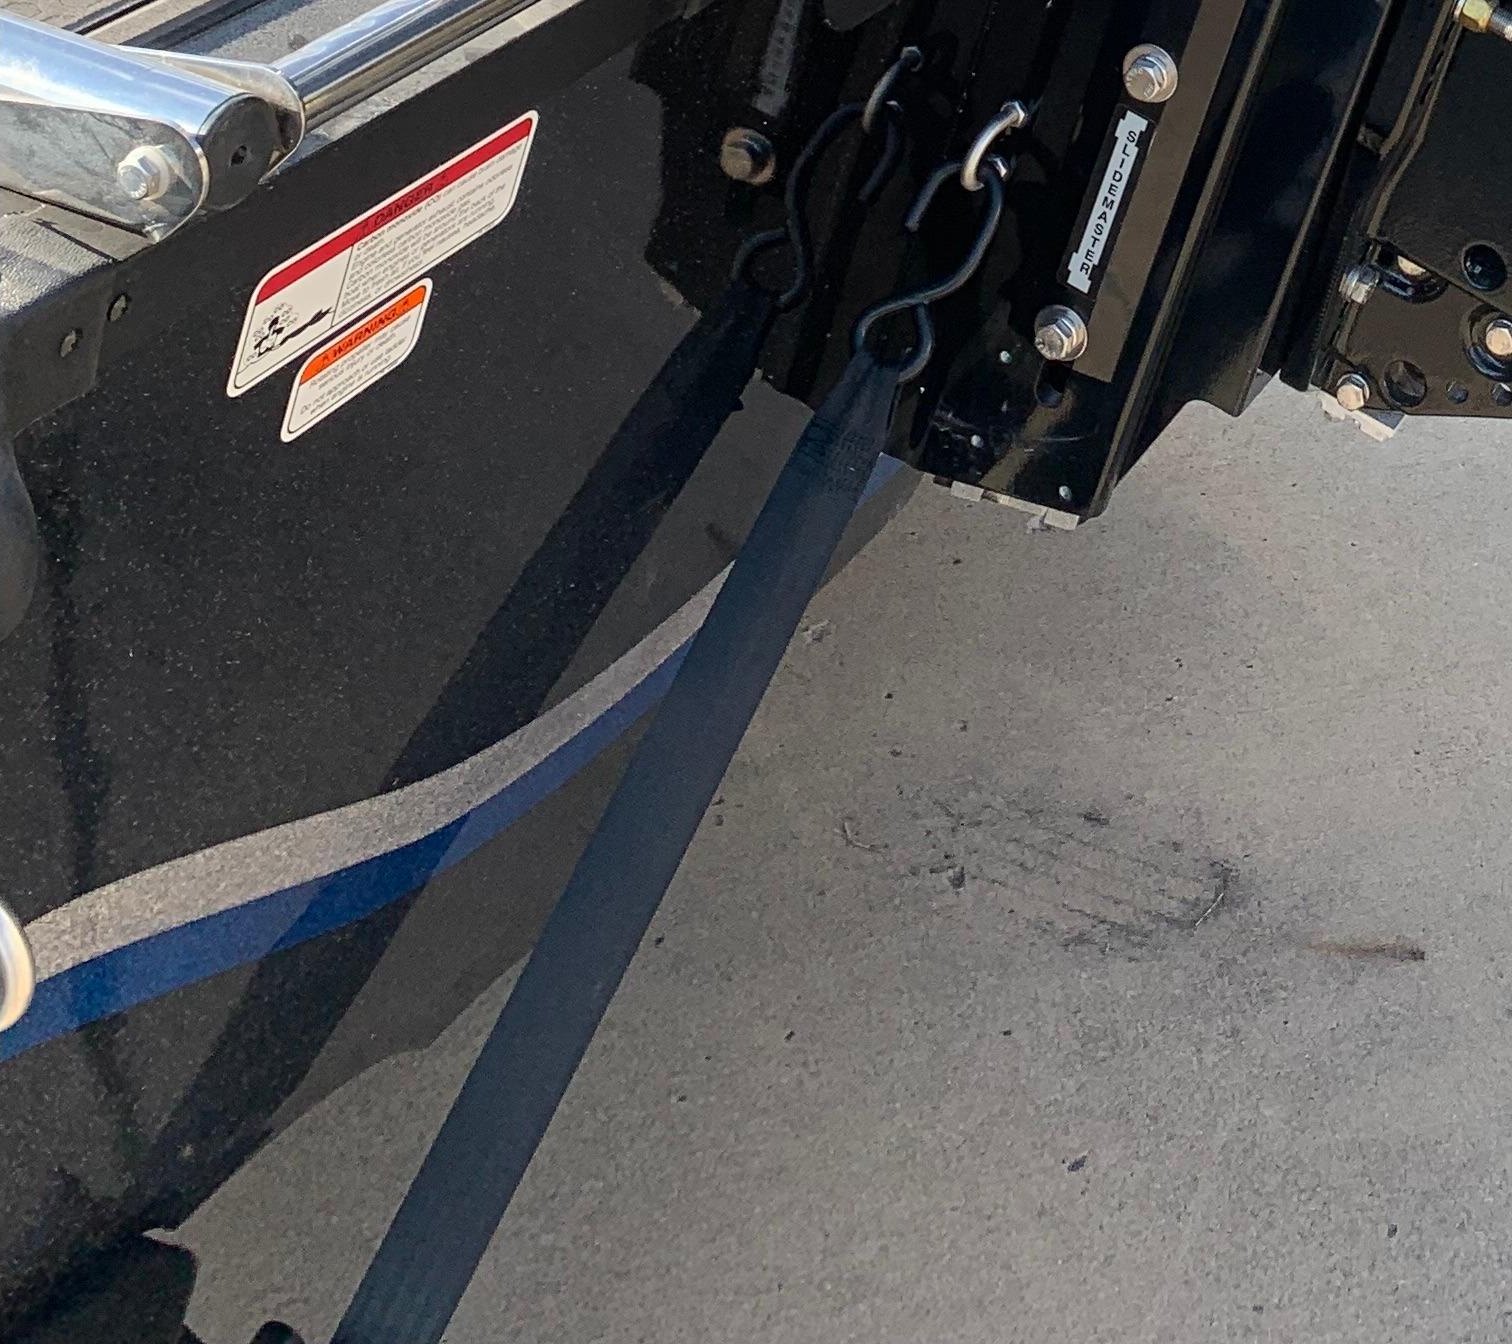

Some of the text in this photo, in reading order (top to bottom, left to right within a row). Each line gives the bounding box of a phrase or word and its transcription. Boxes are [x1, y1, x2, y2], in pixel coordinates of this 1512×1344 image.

[373, 182, 434, 228] DANGER
[1079, 130, 1138, 276] SLIDEMASTER
[332, 307, 396, 358] WARNING
